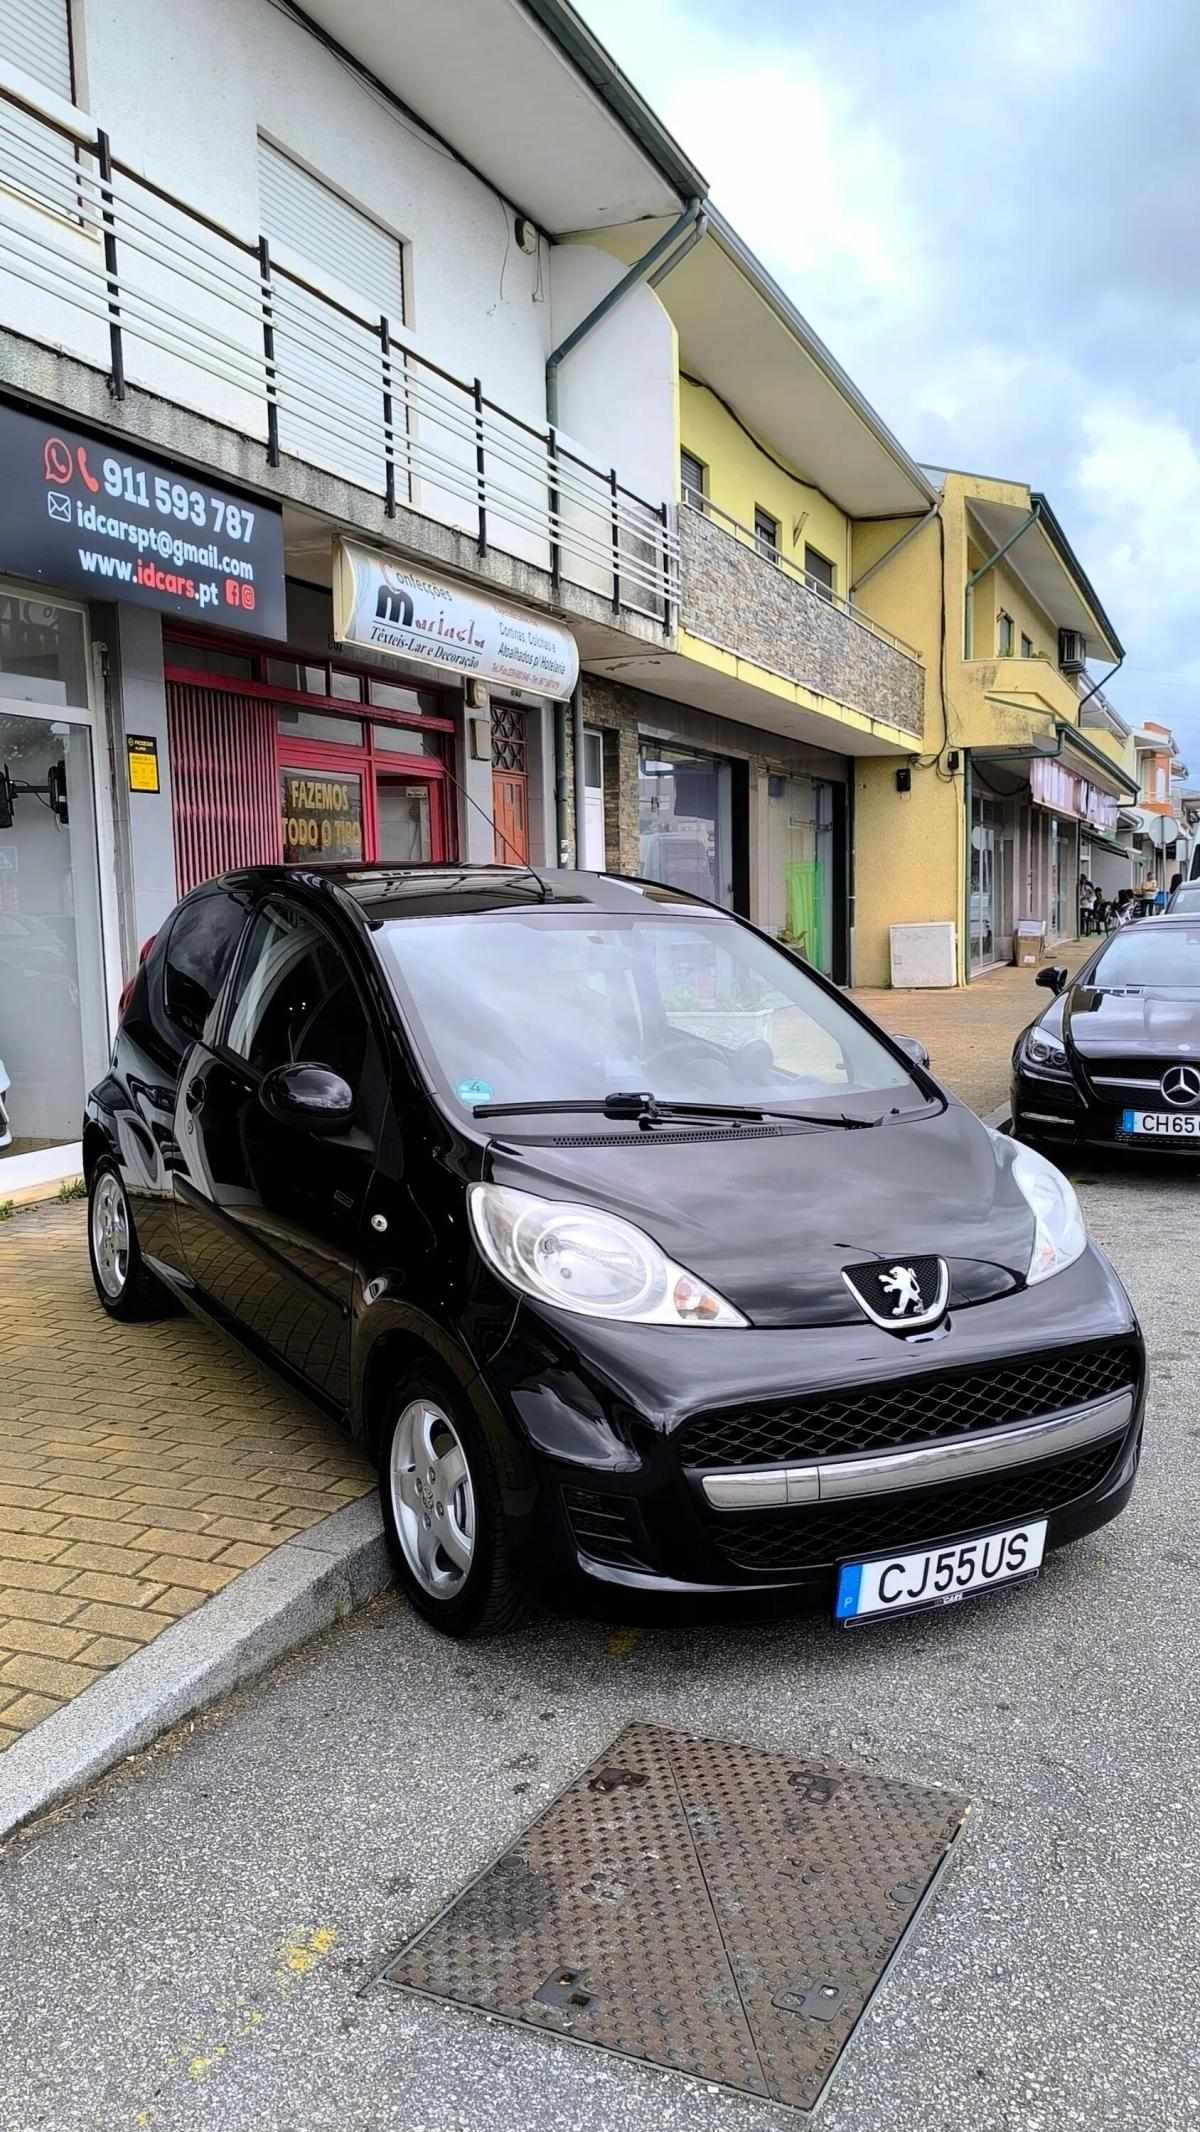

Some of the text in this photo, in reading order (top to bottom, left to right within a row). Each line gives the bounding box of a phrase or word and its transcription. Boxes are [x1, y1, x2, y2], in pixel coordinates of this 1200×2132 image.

[103, 458, 255, 543] 911 593 787
[76, 501, 254, 581] idcarspt@gmail.com
[78, 548, 219, 608] www.idcars.pt
[369, 625, 427, 655] Têxteis-Lar
[427, 647, 434, 656] e
[433, 645, 479, 668] Decoração
[291, 780, 349, 810] FAZEMOS
[281, 816, 318, 846] TODO
[1142, 1114, 1200, 1134] CH65
